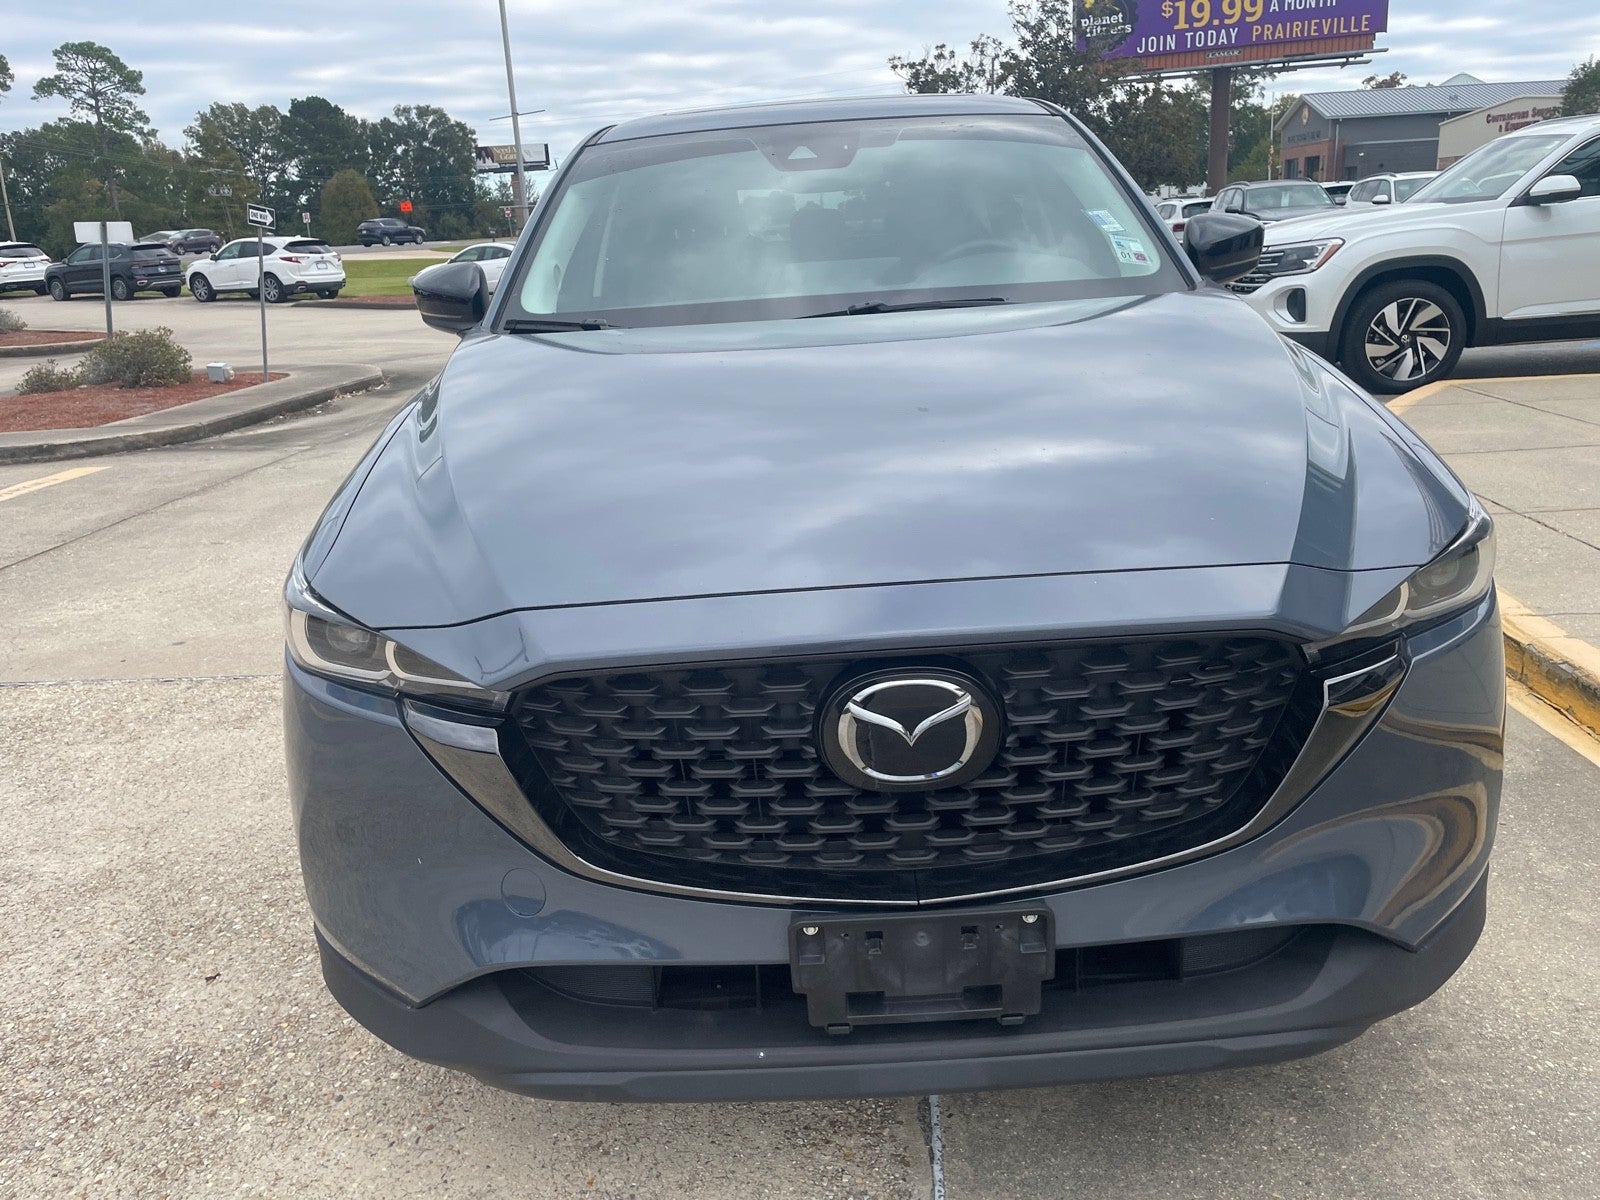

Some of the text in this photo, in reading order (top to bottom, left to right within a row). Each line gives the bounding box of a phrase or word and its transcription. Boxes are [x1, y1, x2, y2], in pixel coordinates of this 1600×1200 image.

[1269, 0, 1279, 12] A
[1081, 12, 1123, 27] planet
[1161, 0, 1264, 30] $19.99
[1136, 14, 1371, 53] JOIN TODAY PRAIRIEVILLE
[251, 211, 268, 221] ONE WAY
[1121, 251, 1131, 259] 01
